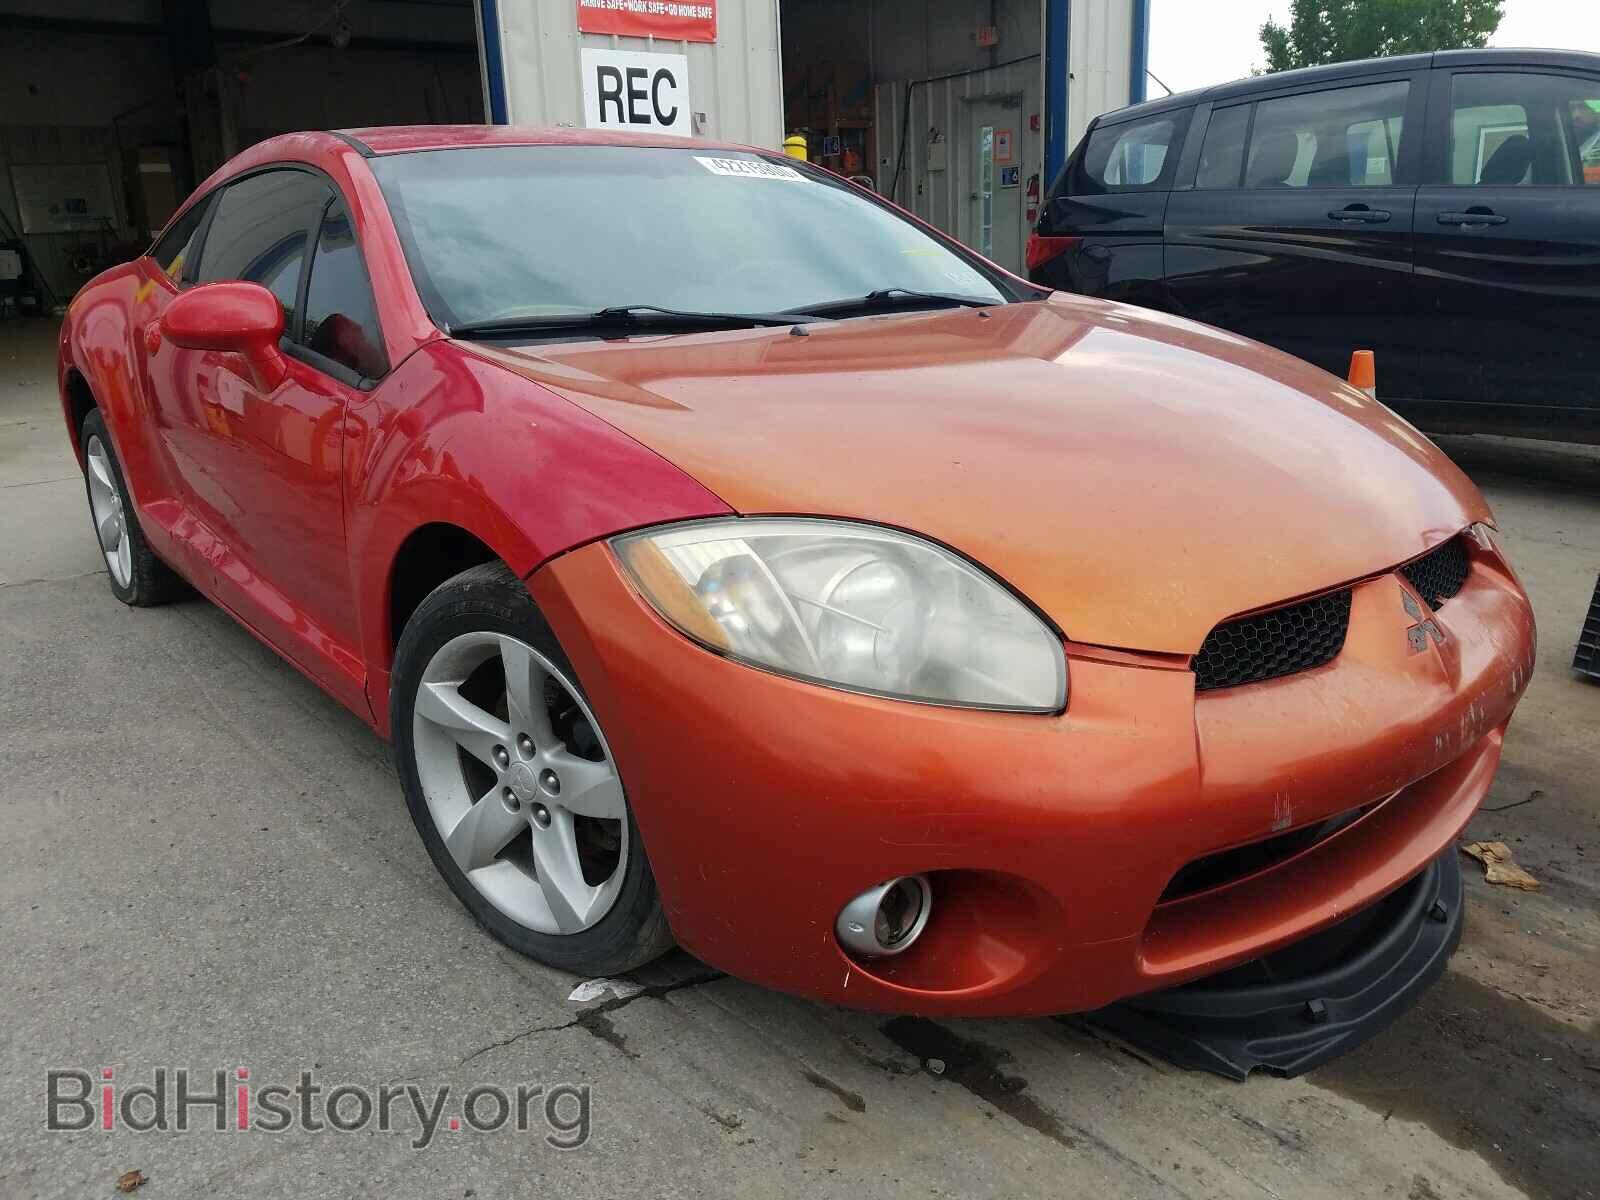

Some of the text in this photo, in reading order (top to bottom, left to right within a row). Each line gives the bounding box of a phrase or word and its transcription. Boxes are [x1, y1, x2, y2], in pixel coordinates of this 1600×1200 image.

[607, 0, 624, 10] SAFE
[628, 0, 647, 13] WORK
[648, 1, 664, 14] SAFE
[668, 3, 678, 16] GO
[679, 4, 697, 17] HOME
[697, 6, 713, 18] SAFE
[597, 65, 678, 126] REC
